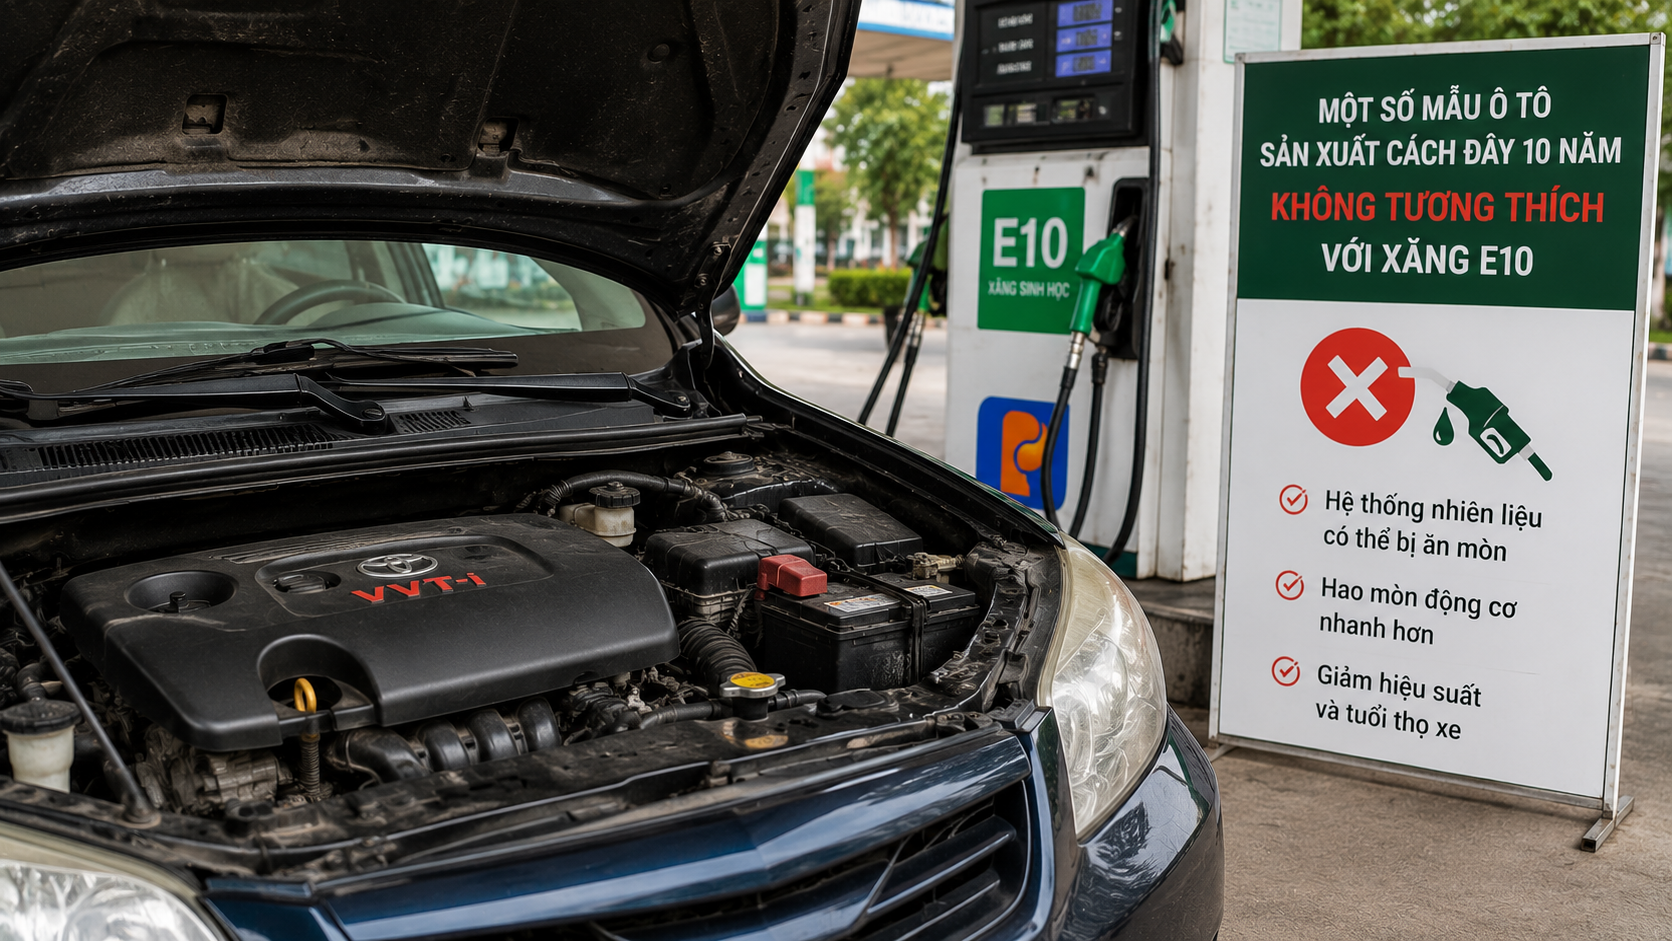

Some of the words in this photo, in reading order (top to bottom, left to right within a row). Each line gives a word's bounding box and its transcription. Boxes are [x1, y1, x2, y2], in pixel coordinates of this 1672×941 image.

[1319, 92, 1373, 128] MỘT
[1381, 88, 1414, 121] SỐ
[1423, 85, 1480, 120] MẪU
[1490, 87, 1507, 119] Ô
[1516, 86, 1551, 118] TÔ
[1260, 134, 1308, 167] SẢN
[1316, 134, 1380, 166] XUẤT
[1387, 134, 1455, 165] CÁCH
[1463, 133, 1515, 164] ĐÂY
[1524, 138, 1550, 164] 10
[1560, 131, 1621, 163] NĂM
[1272, 185, 1375, 221] KHÔNG
[1385, 191, 1494, 221] TƯƠNG
[1505, 185, 1604, 222] THÍCH
[993, 217, 1067, 268] E10
[1322, 237, 1371, 272] VỚI
[1382, 238, 1469, 274] XĂNG
[1481, 246, 1533, 276] E10
[988, 277, 1017, 295] XĂNG
[1020, 281, 1044, 296] SINH
[1047, 282, 1070, 300] HỌC
[1326, 490, 1353, 516] Hệ
[1361, 493, 1423, 523] thống
[1432, 499, 1493, 523] nhiên
[1502, 504, 1541, 531] liệu
[1324, 526, 1348, 546] có
[1356, 527, 1390, 550] thể
[1397, 530, 1415, 557] bị
[1424, 534, 1449, 556] ăn
[1458, 538, 1506, 561] mòn
[351, 573, 486, 603] VVT-i
[1322, 577, 1363, 600] Hao
[1371, 584, 1417, 606] mòn
[1425, 588, 1480, 619] động
[1489, 601, 1517, 618] cơ
[1320, 612, 1385, 638] nhanh
[1394, 619, 1433, 644] hơn
[1318, 665, 1371, 690] Giảm
[1379, 672, 1425, 701] hiệu
[1433, 684, 1481, 707] suất
[1316, 700, 1338, 720] và
[1346, 704, 1386, 728] tuổi
[1394, 711, 1428, 738] thọ
[1436, 722, 1460, 739] xe
